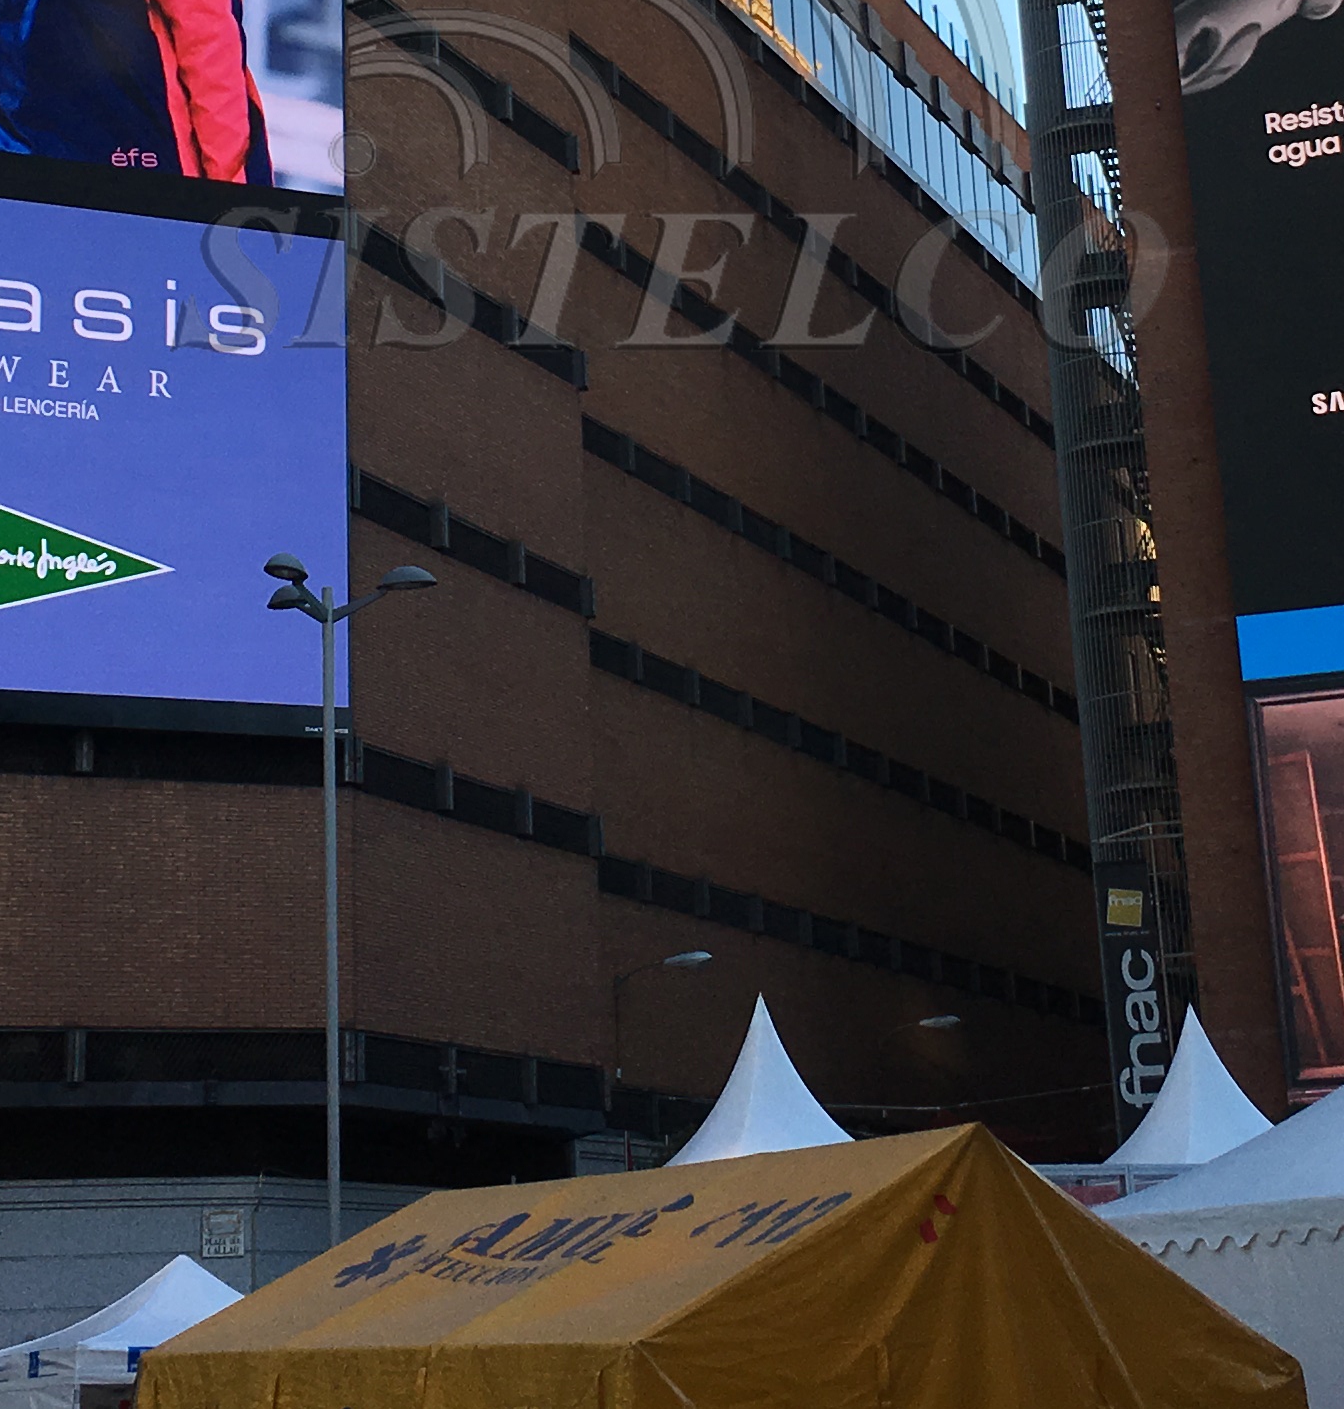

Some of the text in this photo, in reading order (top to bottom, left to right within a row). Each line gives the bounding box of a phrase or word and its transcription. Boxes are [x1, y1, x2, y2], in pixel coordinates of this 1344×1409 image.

[111, 146, 159, 168] éfs
[1267, 135, 1341, 168] agua
[3, 396, 100, 421] LENCERÍA
[36, 538, 117, 581] Inglés
[1119, 948, 1166, 1110] fnac
